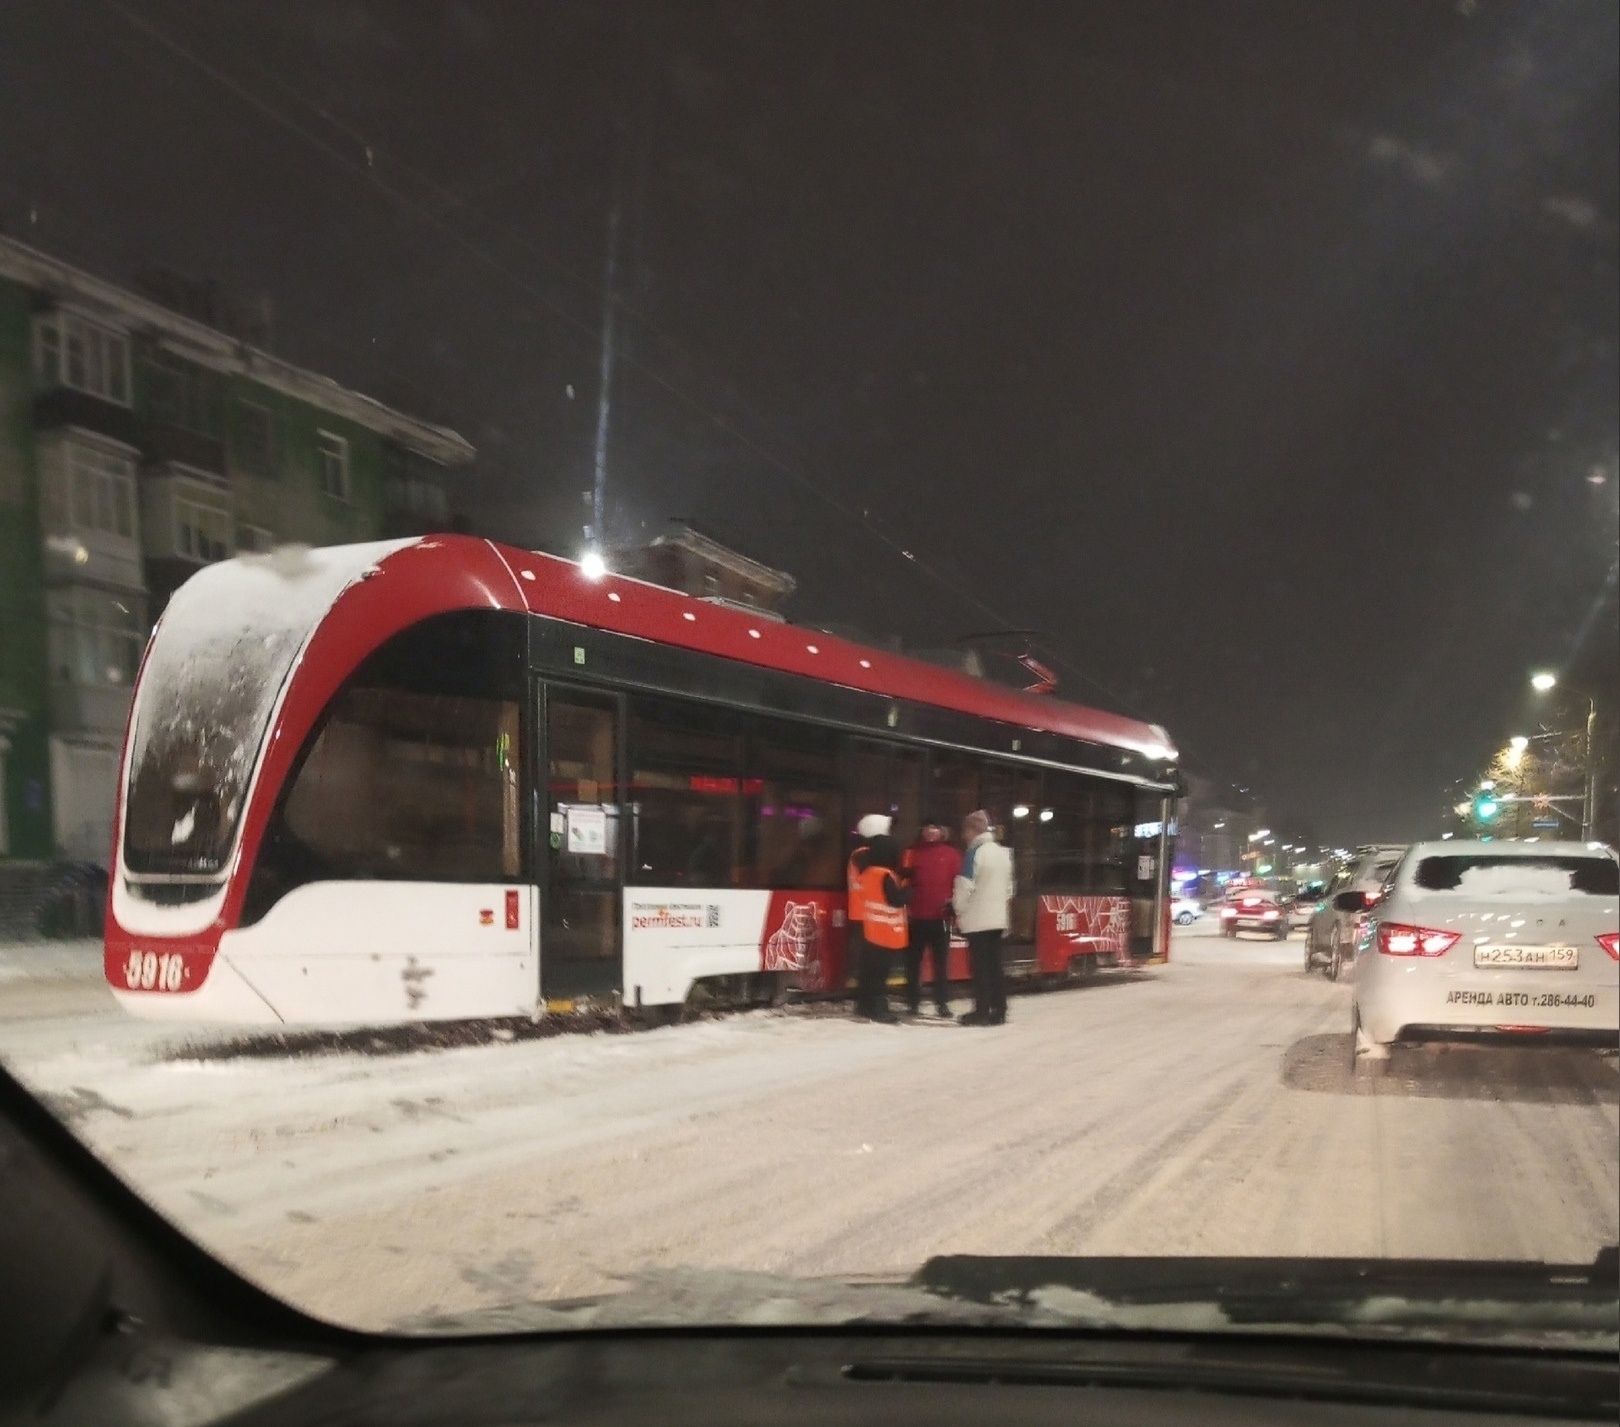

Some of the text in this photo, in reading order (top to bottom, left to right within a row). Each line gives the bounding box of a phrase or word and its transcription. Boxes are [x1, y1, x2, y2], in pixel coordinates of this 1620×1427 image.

[632, 912, 702, 930] permfest.ru
[1549, 948, 1574, 961] 159
[1446, 990, 1493, 1007] АРЕНДА
[1496, 992, 1529, 1007] АВТО
